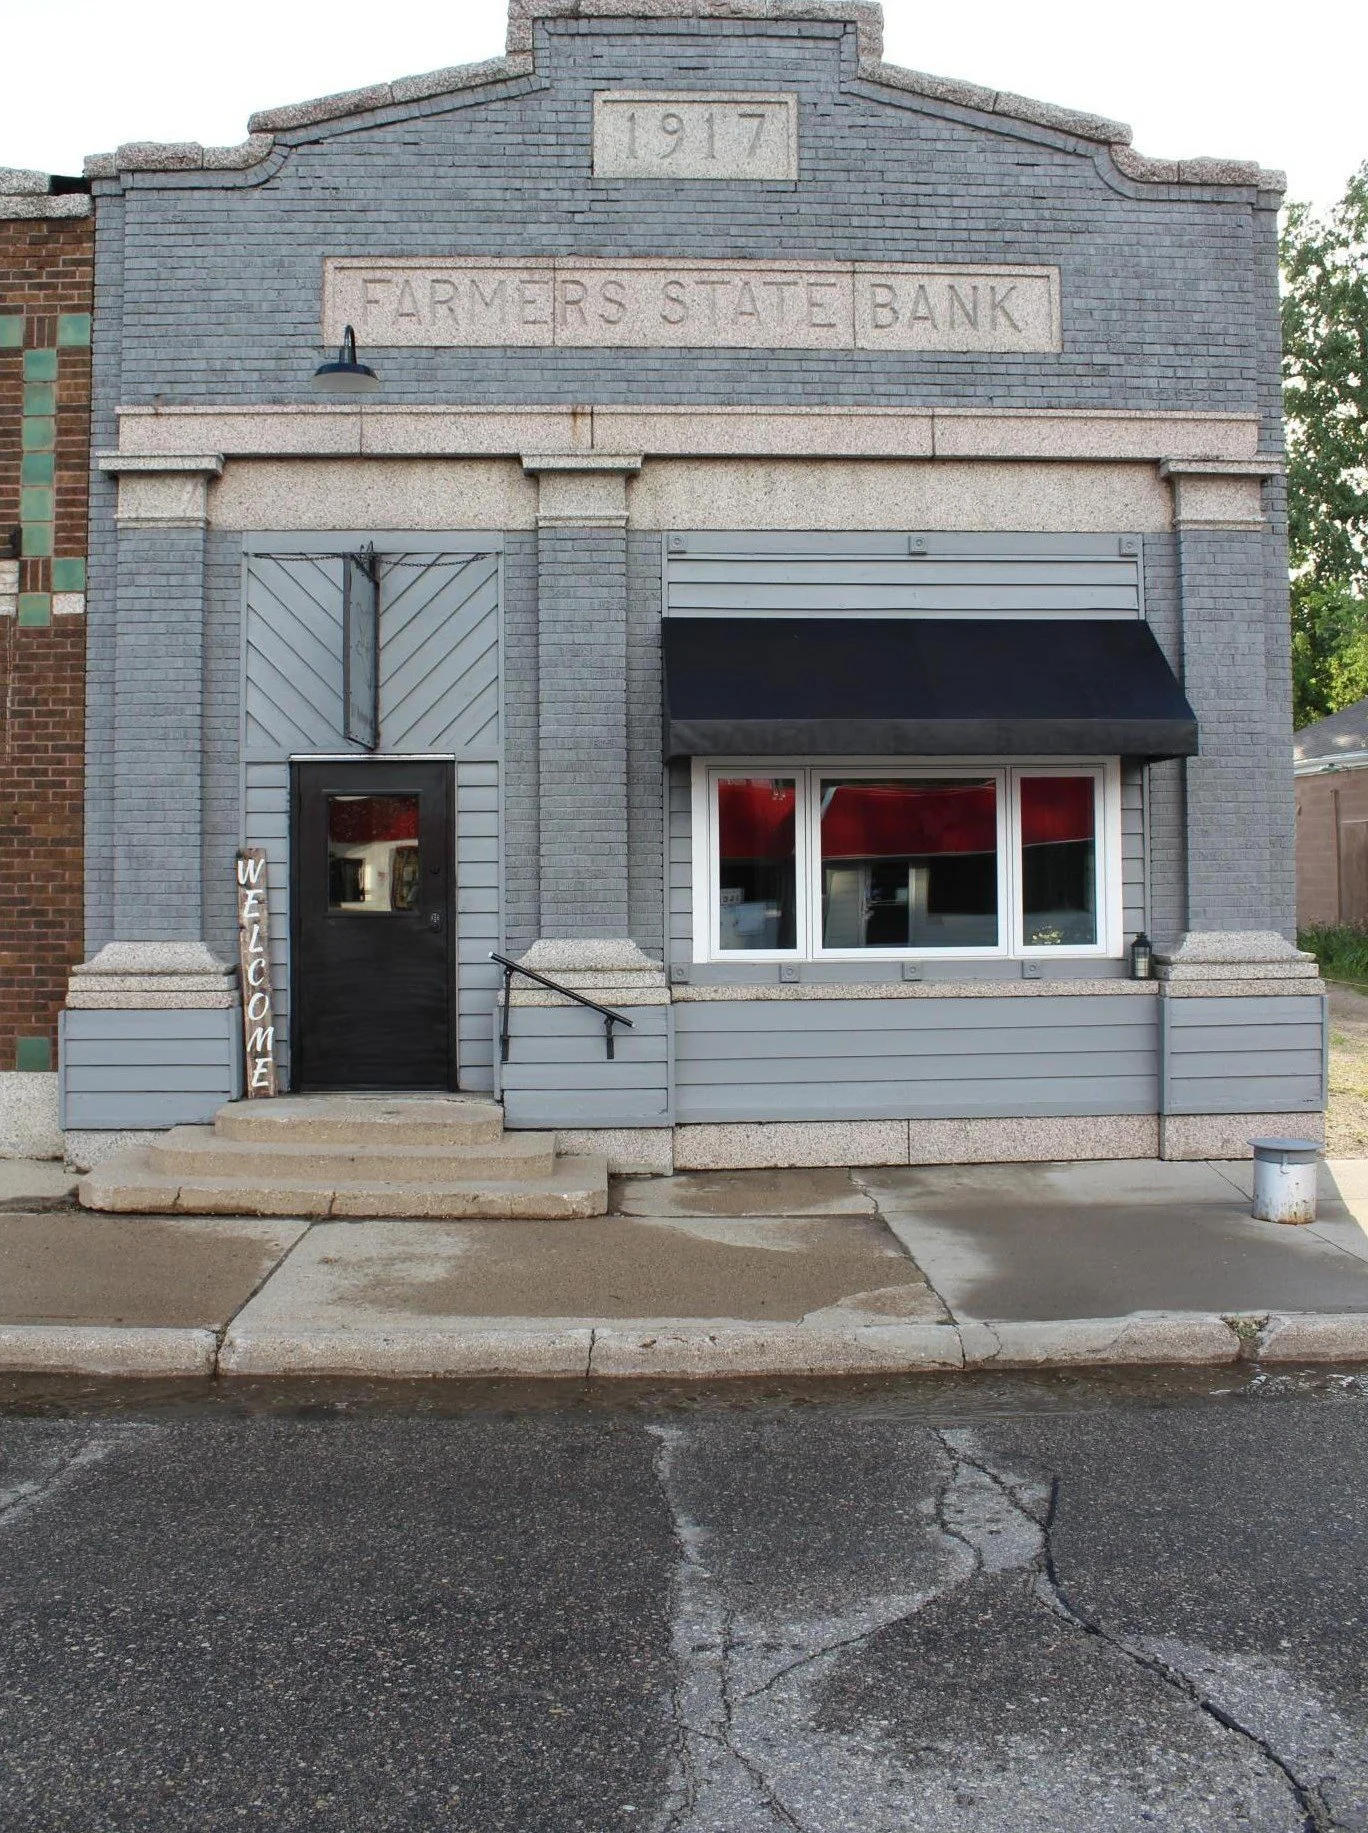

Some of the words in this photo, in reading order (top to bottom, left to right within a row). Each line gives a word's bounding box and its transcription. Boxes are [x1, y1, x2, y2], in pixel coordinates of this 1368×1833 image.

[626, 112, 766, 159] 1917
[362, 278, 627, 326] FARMERS
[659, 279, 837, 328] STATE
[870, 283, 1022, 333] BANK
[237, 858, 275, 1088] WELCOME
